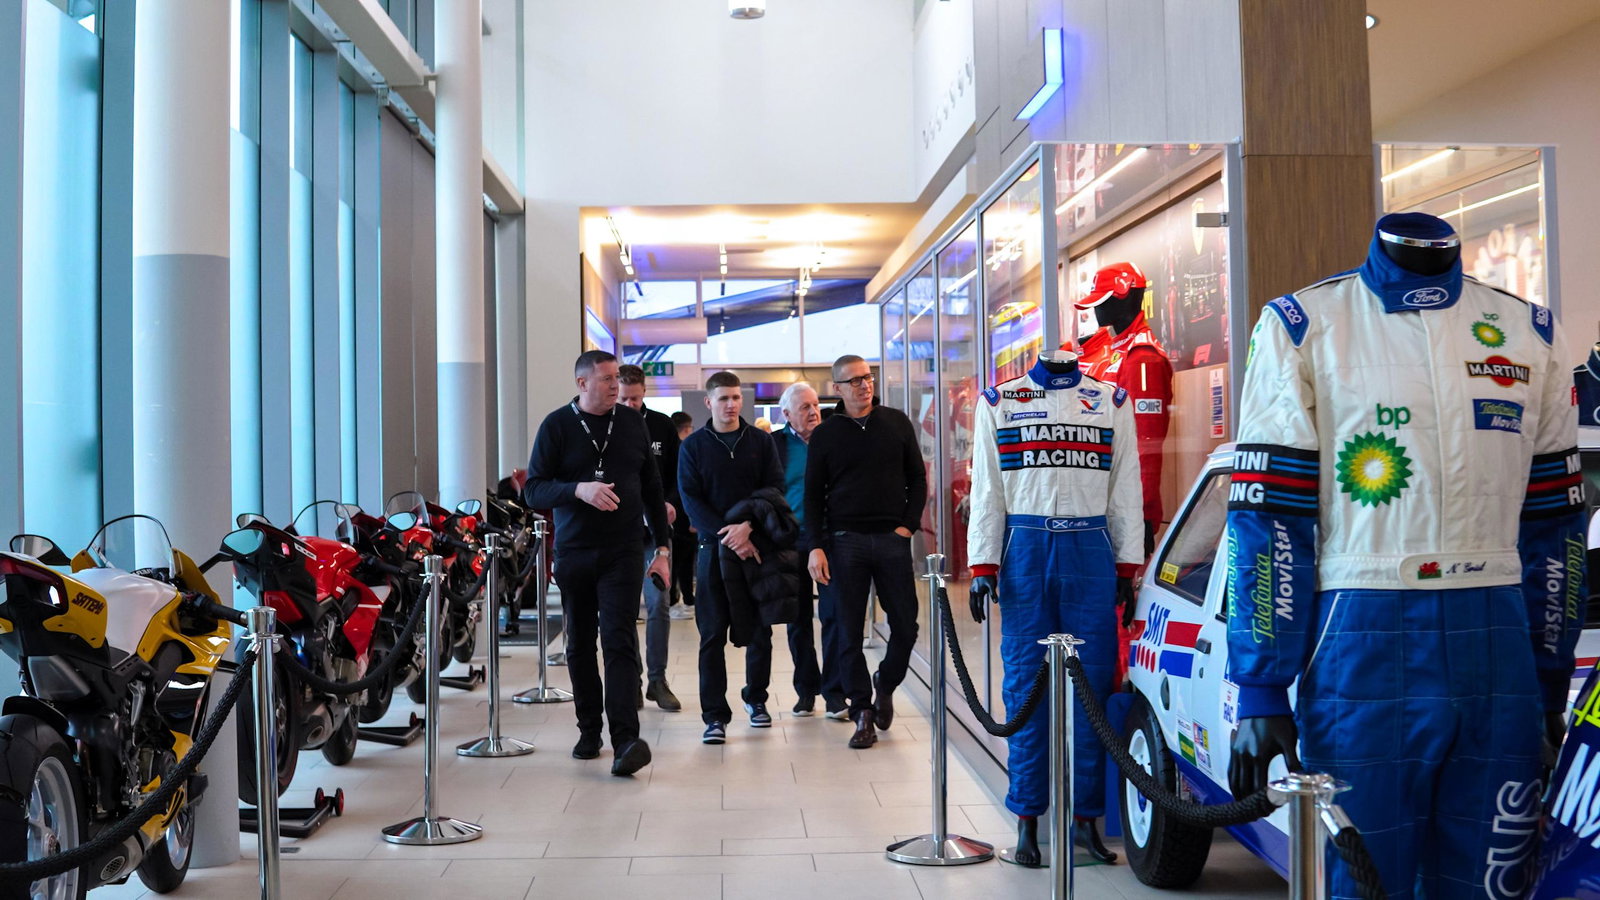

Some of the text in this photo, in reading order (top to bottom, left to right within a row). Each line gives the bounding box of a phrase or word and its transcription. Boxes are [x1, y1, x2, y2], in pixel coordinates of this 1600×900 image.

[1413, 290, 1441, 303] Ford
[1482, 312, 1499, 321] bp
[1469, 364, 1529, 381] MARTINI
[1376, 403, 1411, 430] bp
[1021, 424, 1100, 443] MARTINI
[1023, 450, 1100, 468] RACING
[1273, 520, 1293, 621] MoviStar
[1544, 557, 1564, 654] MoviStar
[1142, 602, 1171, 647] SMT
